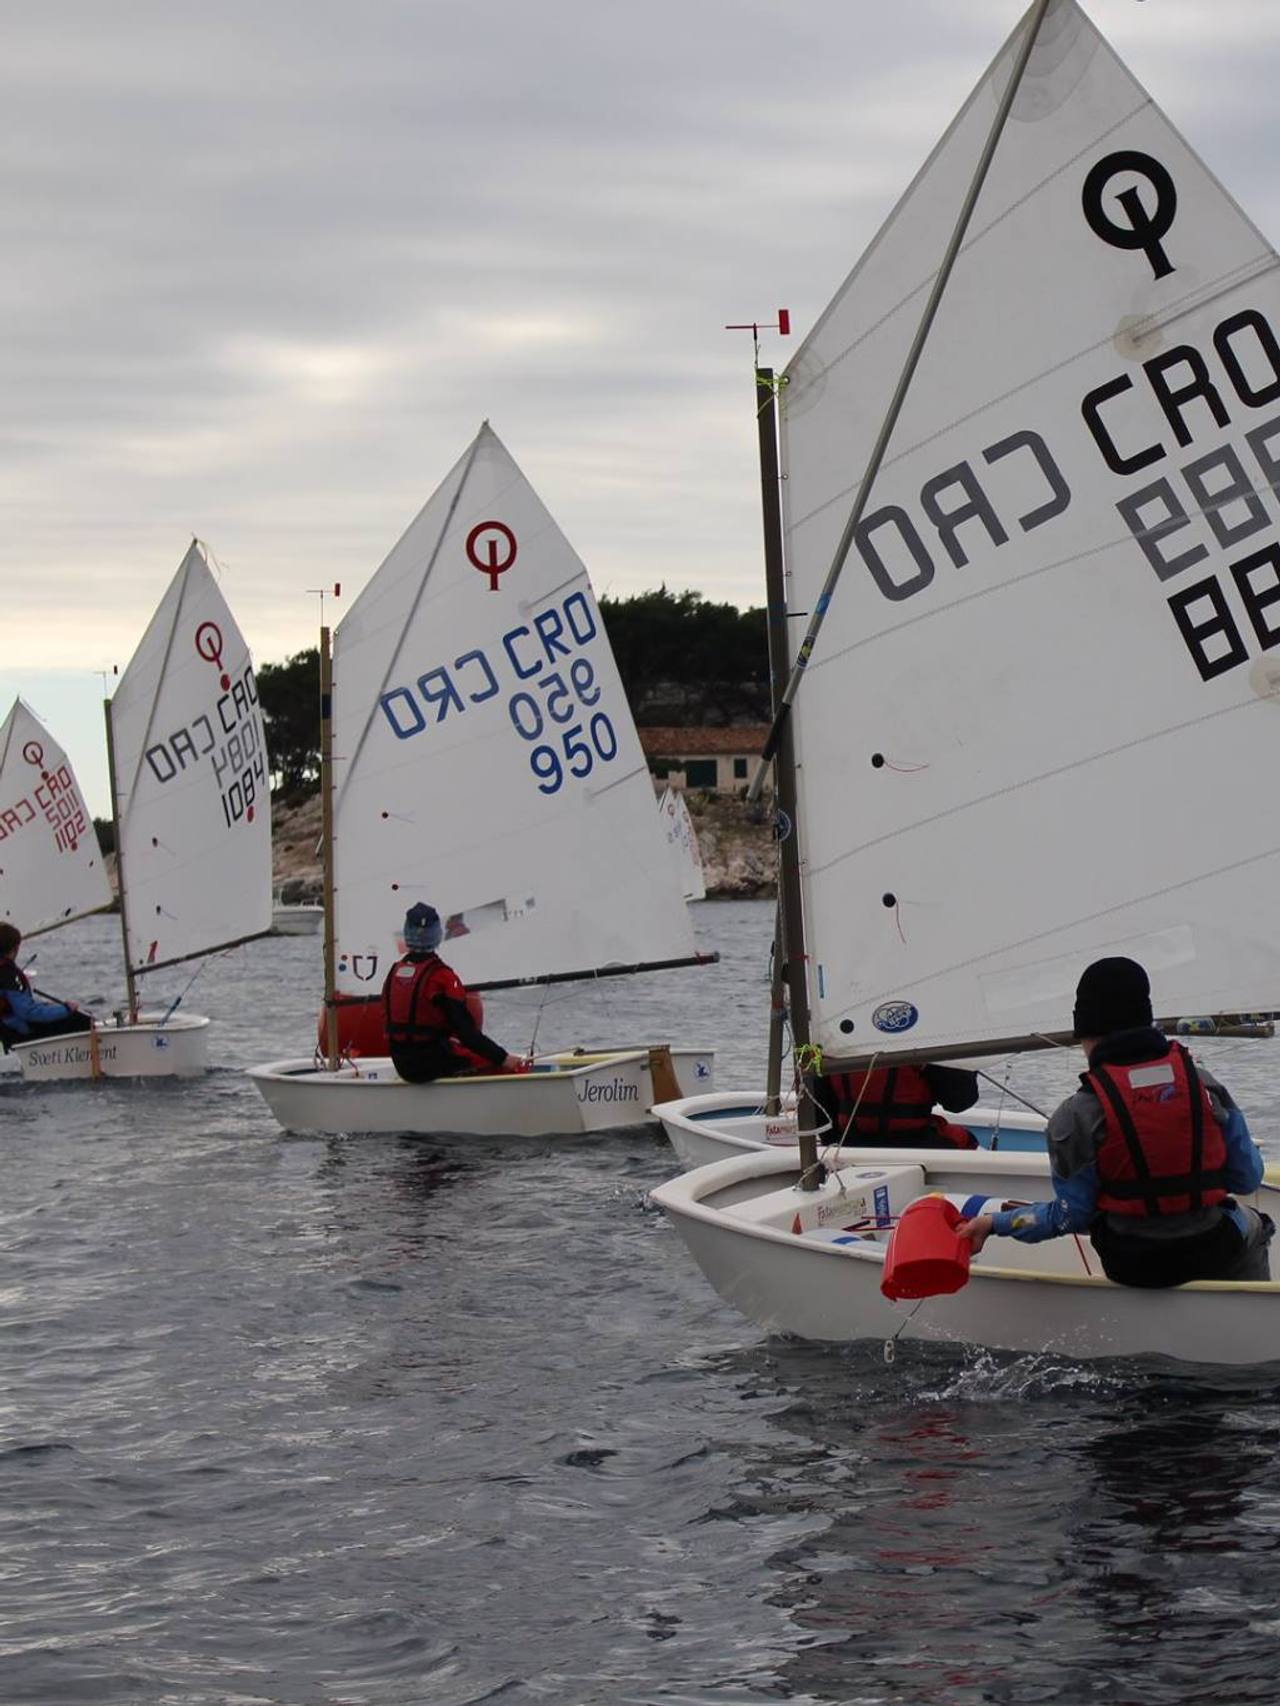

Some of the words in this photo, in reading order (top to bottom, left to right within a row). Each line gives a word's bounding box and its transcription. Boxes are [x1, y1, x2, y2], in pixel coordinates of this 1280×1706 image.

[503, 591, 597, 680] CRO
[530, 713, 617, 794] 950
[35, 766, 72, 809] CRO
[221, 752, 265, 828] 1084
[55, 810, 86, 853] 1102
[578, 1077, 639, 1103] Jerolim
